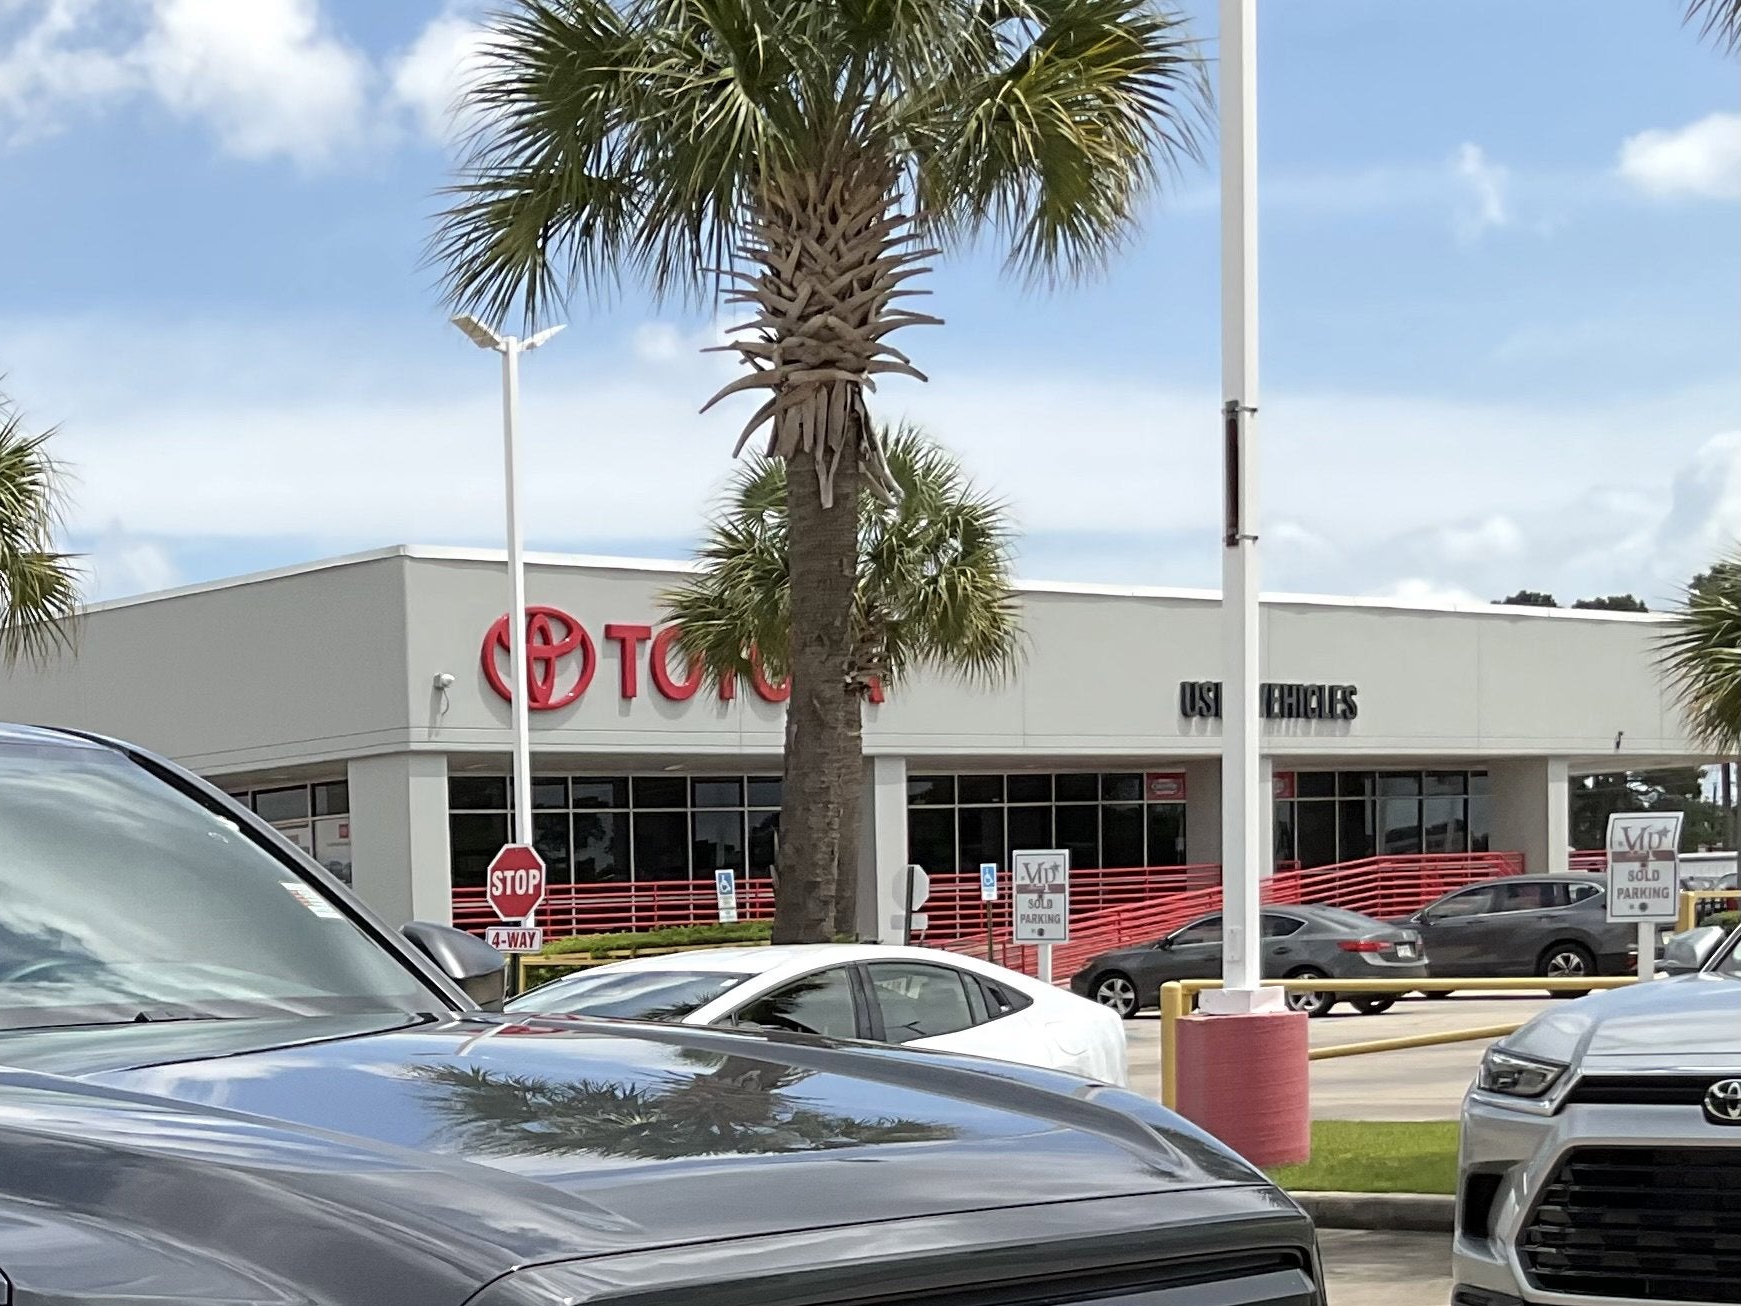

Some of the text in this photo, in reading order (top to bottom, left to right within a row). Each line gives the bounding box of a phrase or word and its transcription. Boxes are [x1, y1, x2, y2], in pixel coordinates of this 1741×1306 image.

[605, 623, 885, 704] TOO
[1627, 869, 1660, 882] SOLD
[491, 868, 541, 897] STOP
[1617, 887, 1670, 900] PARKING
[1027, 898, 1053, 910] SOLD
[1020, 913, 1061, 925] PARKING
[491, 931, 537, 950] 4-WAY
